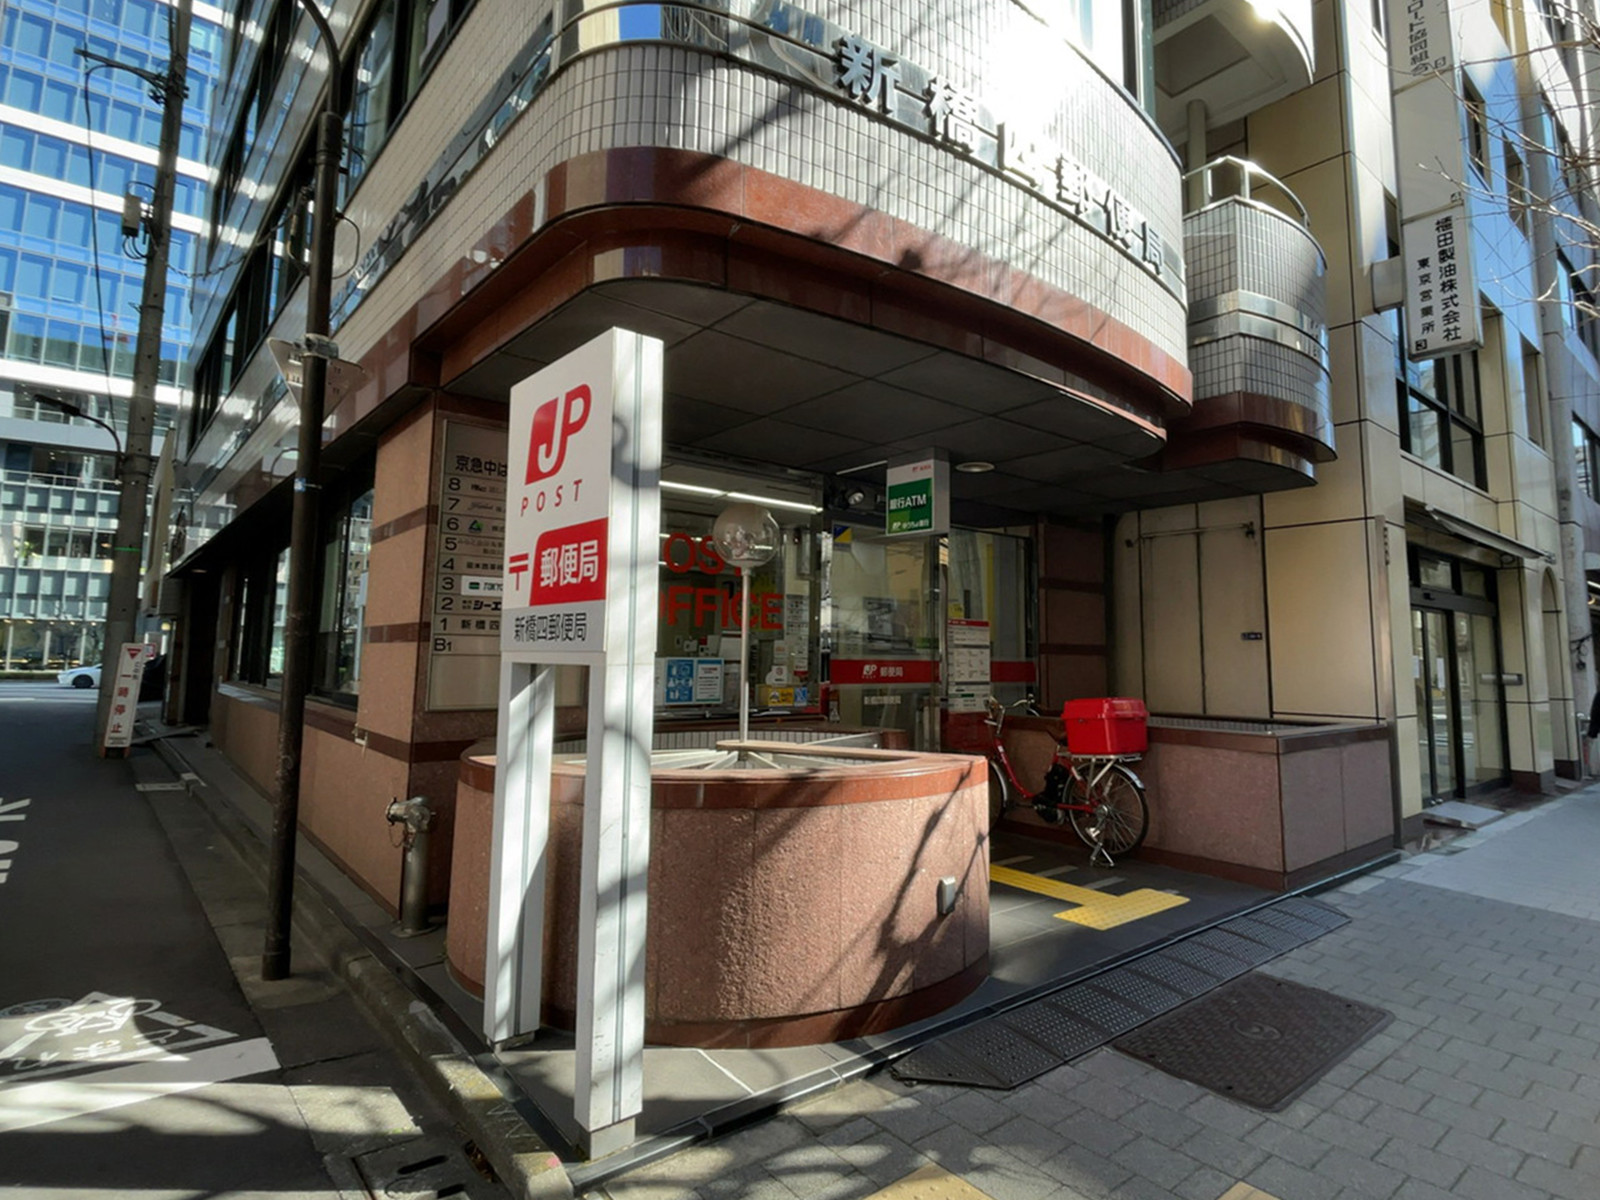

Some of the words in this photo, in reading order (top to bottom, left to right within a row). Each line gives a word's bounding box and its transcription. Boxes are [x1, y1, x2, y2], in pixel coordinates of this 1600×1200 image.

[1408, 0, 1428, 76] ロード協同組合
[525, 384, 592, 485] JP
[448, 477, 461, 491] 8
[448, 497, 461, 511] 7
[520, 479, 583, 517] POST
[446, 517, 460, 531] 6
[444, 537, 458, 551] 5
[663, 532, 742, 577] OS
[442, 558, 455, 571] 4
[540, 540, 599, 588] 郵便局
[442, 577, 455, 591] 3
[441, 597, 454, 611] 2
[659, 585, 784, 630] FFICE
[440, 618, 448, 631] 1
[514, 612, 587, 642] 新橋四郵便局
[434, 638, 452, 652] B1
[110, 674, 132, 733] 一時停止
